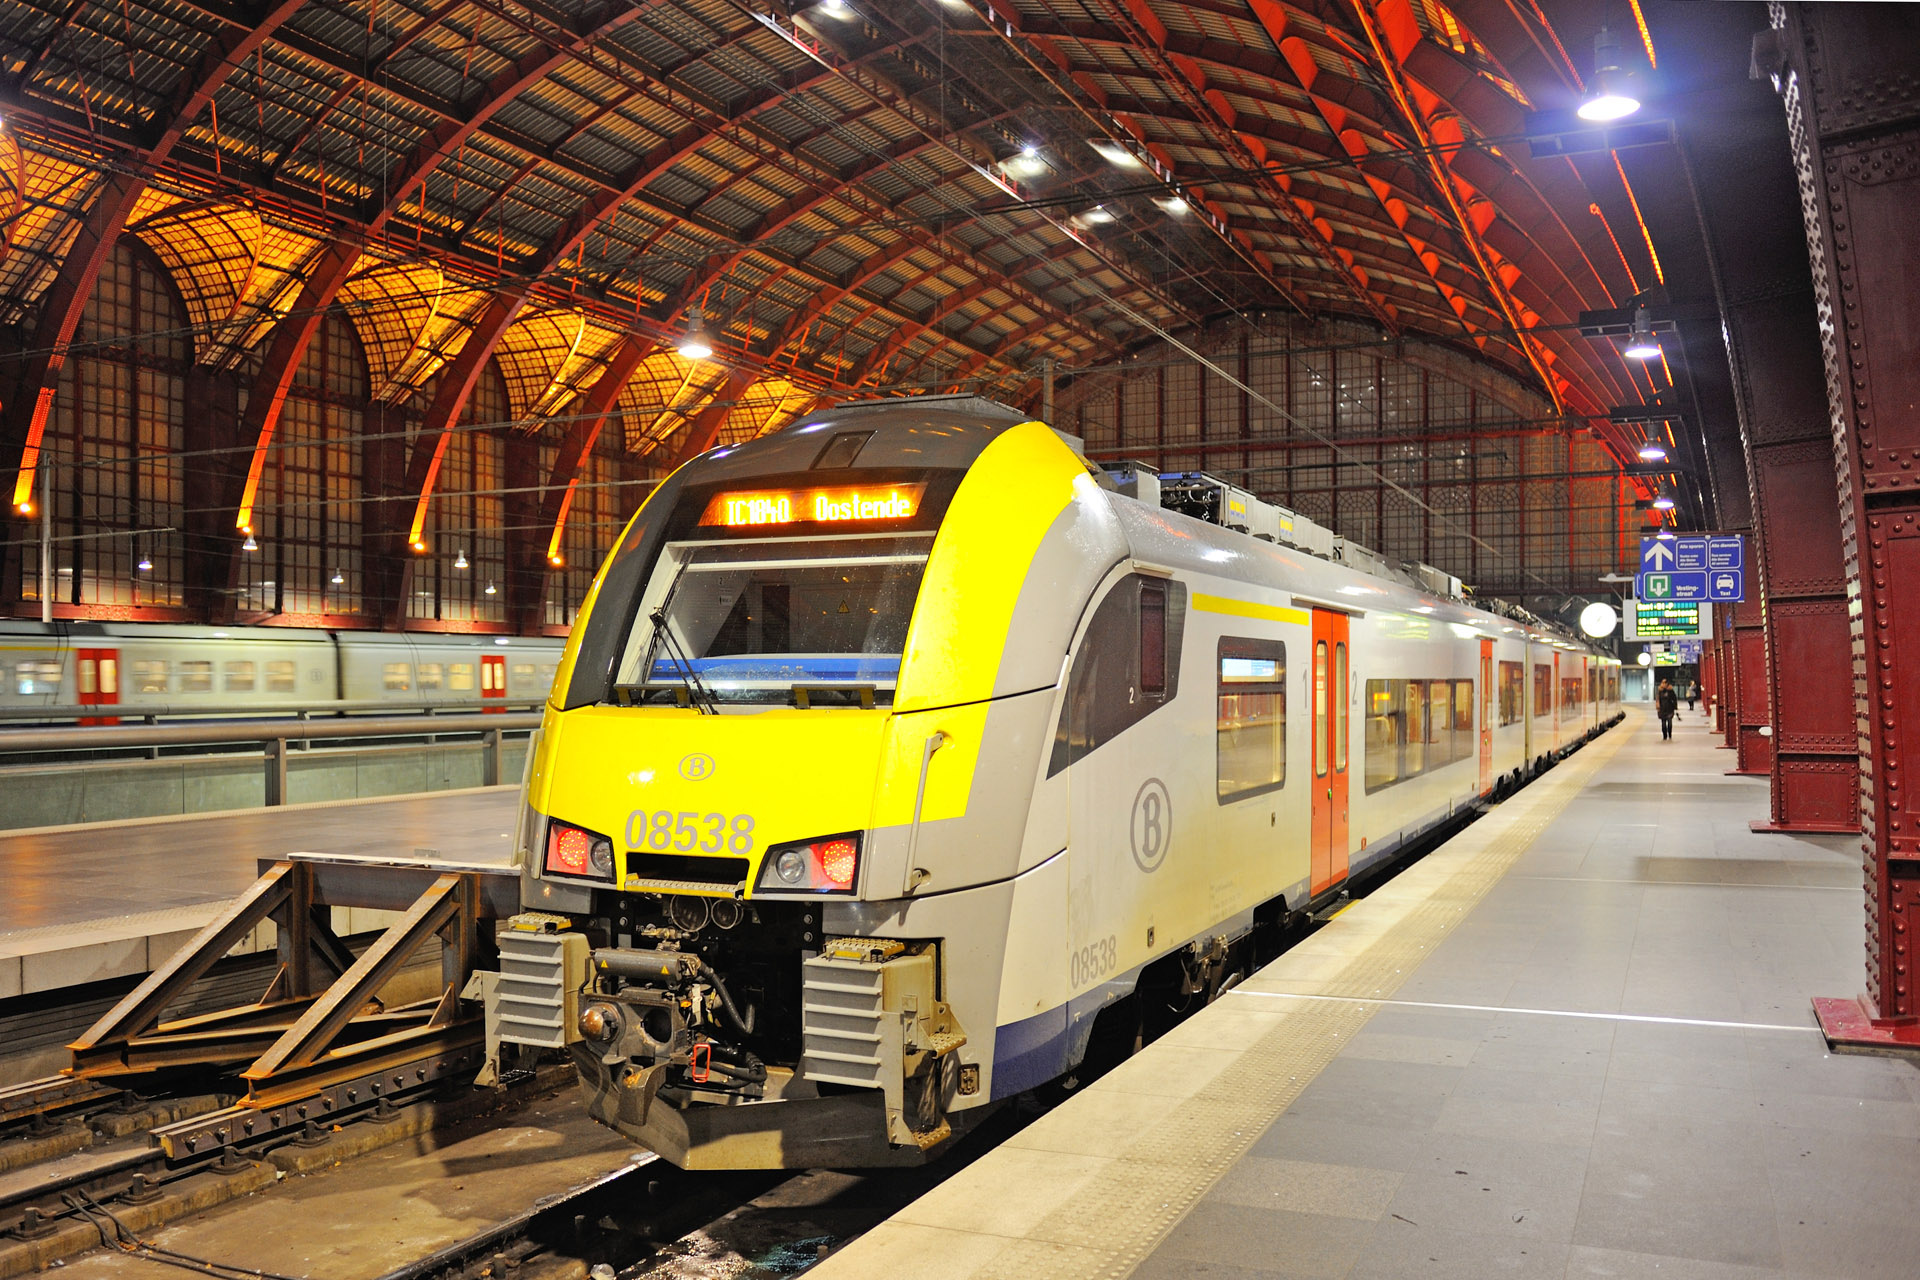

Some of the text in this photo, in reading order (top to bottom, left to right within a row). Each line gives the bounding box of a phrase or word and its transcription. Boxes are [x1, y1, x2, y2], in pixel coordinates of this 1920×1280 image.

[727, 491, 911, 526] IC1840 Oostende
[1129, 686, 1135, 704] 2
[1302, 668, 1308, 709] 1
[1352, 670, 1358, 706] 2
[625, 809, 756, 855] 08538
[1070, 934, 1117, 990] 08538
